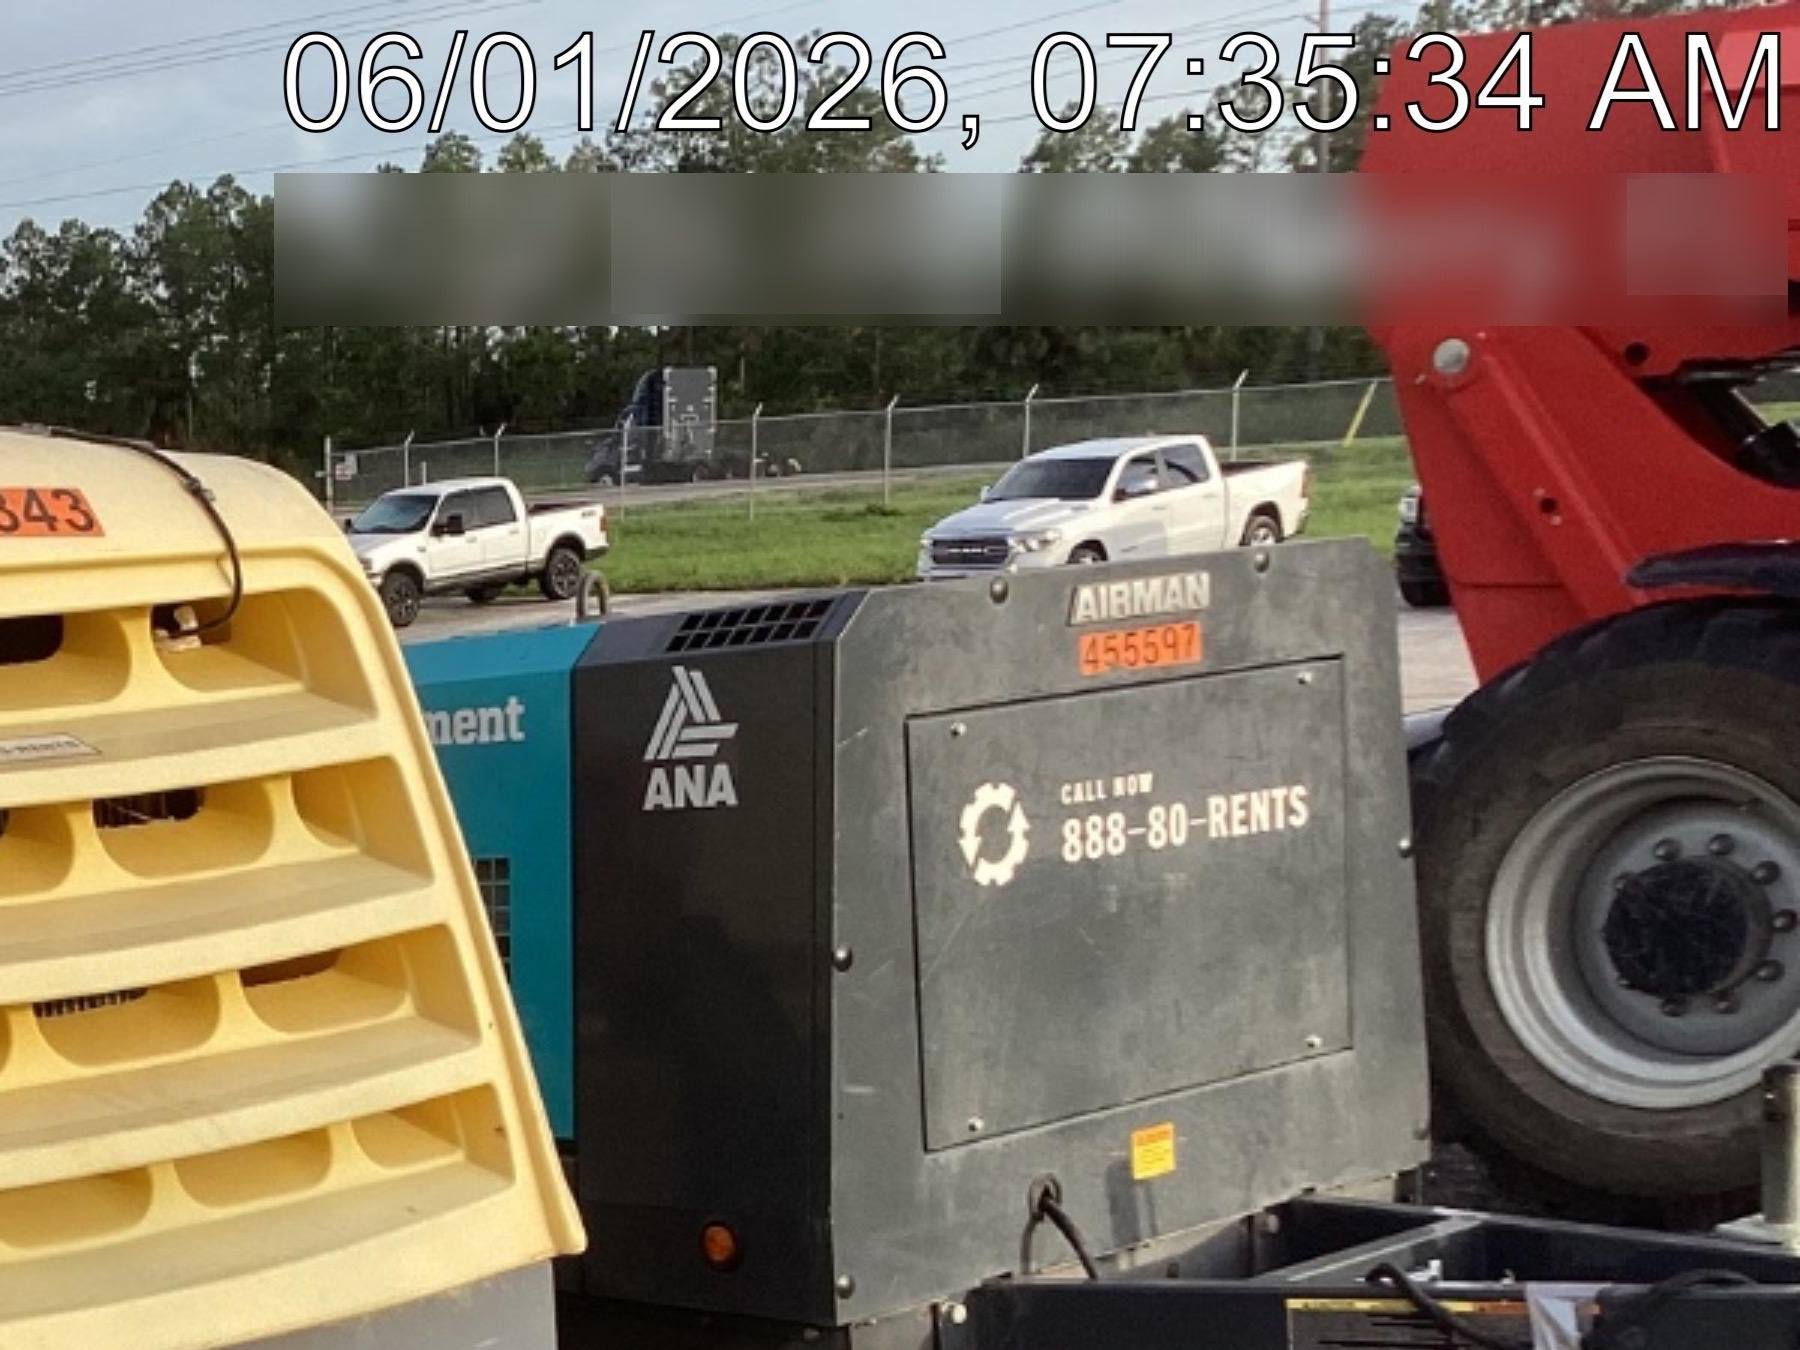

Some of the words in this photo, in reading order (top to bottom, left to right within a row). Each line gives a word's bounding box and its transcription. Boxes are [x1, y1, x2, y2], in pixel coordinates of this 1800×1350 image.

[1070, 571, 1210, 624] AIRMAN
[1084, 623, 1196, 671] 455597
[643, 763, 738, 810] ANA
[1061, 780, 1107, 804] CALL
[1112, 773, 1153, 796] NOW
[1062, 785, 1310, 863] 888-80-RENTS
